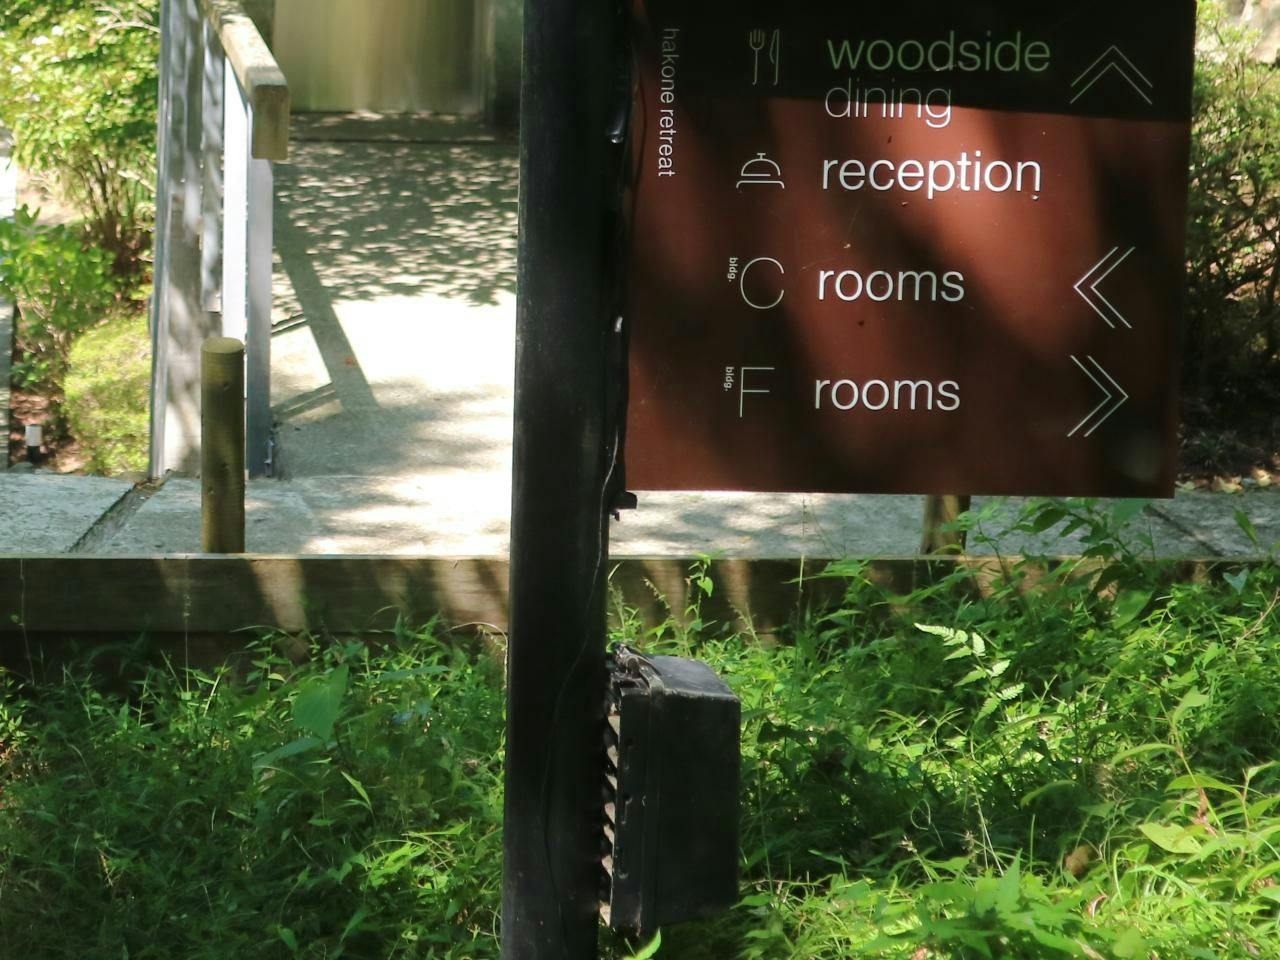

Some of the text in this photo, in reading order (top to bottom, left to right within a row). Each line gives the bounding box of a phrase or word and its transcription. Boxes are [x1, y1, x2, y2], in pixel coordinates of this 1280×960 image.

[826, 30, 1052, 73] woodside
[657, 27, 680, 177] hakone retreat
[825, 78, 951, 128] dining
[821, 149, 1043, 200] reception
[740, 256, 966, 310] C rooms
[740, 367, 962, 417] F rooms
